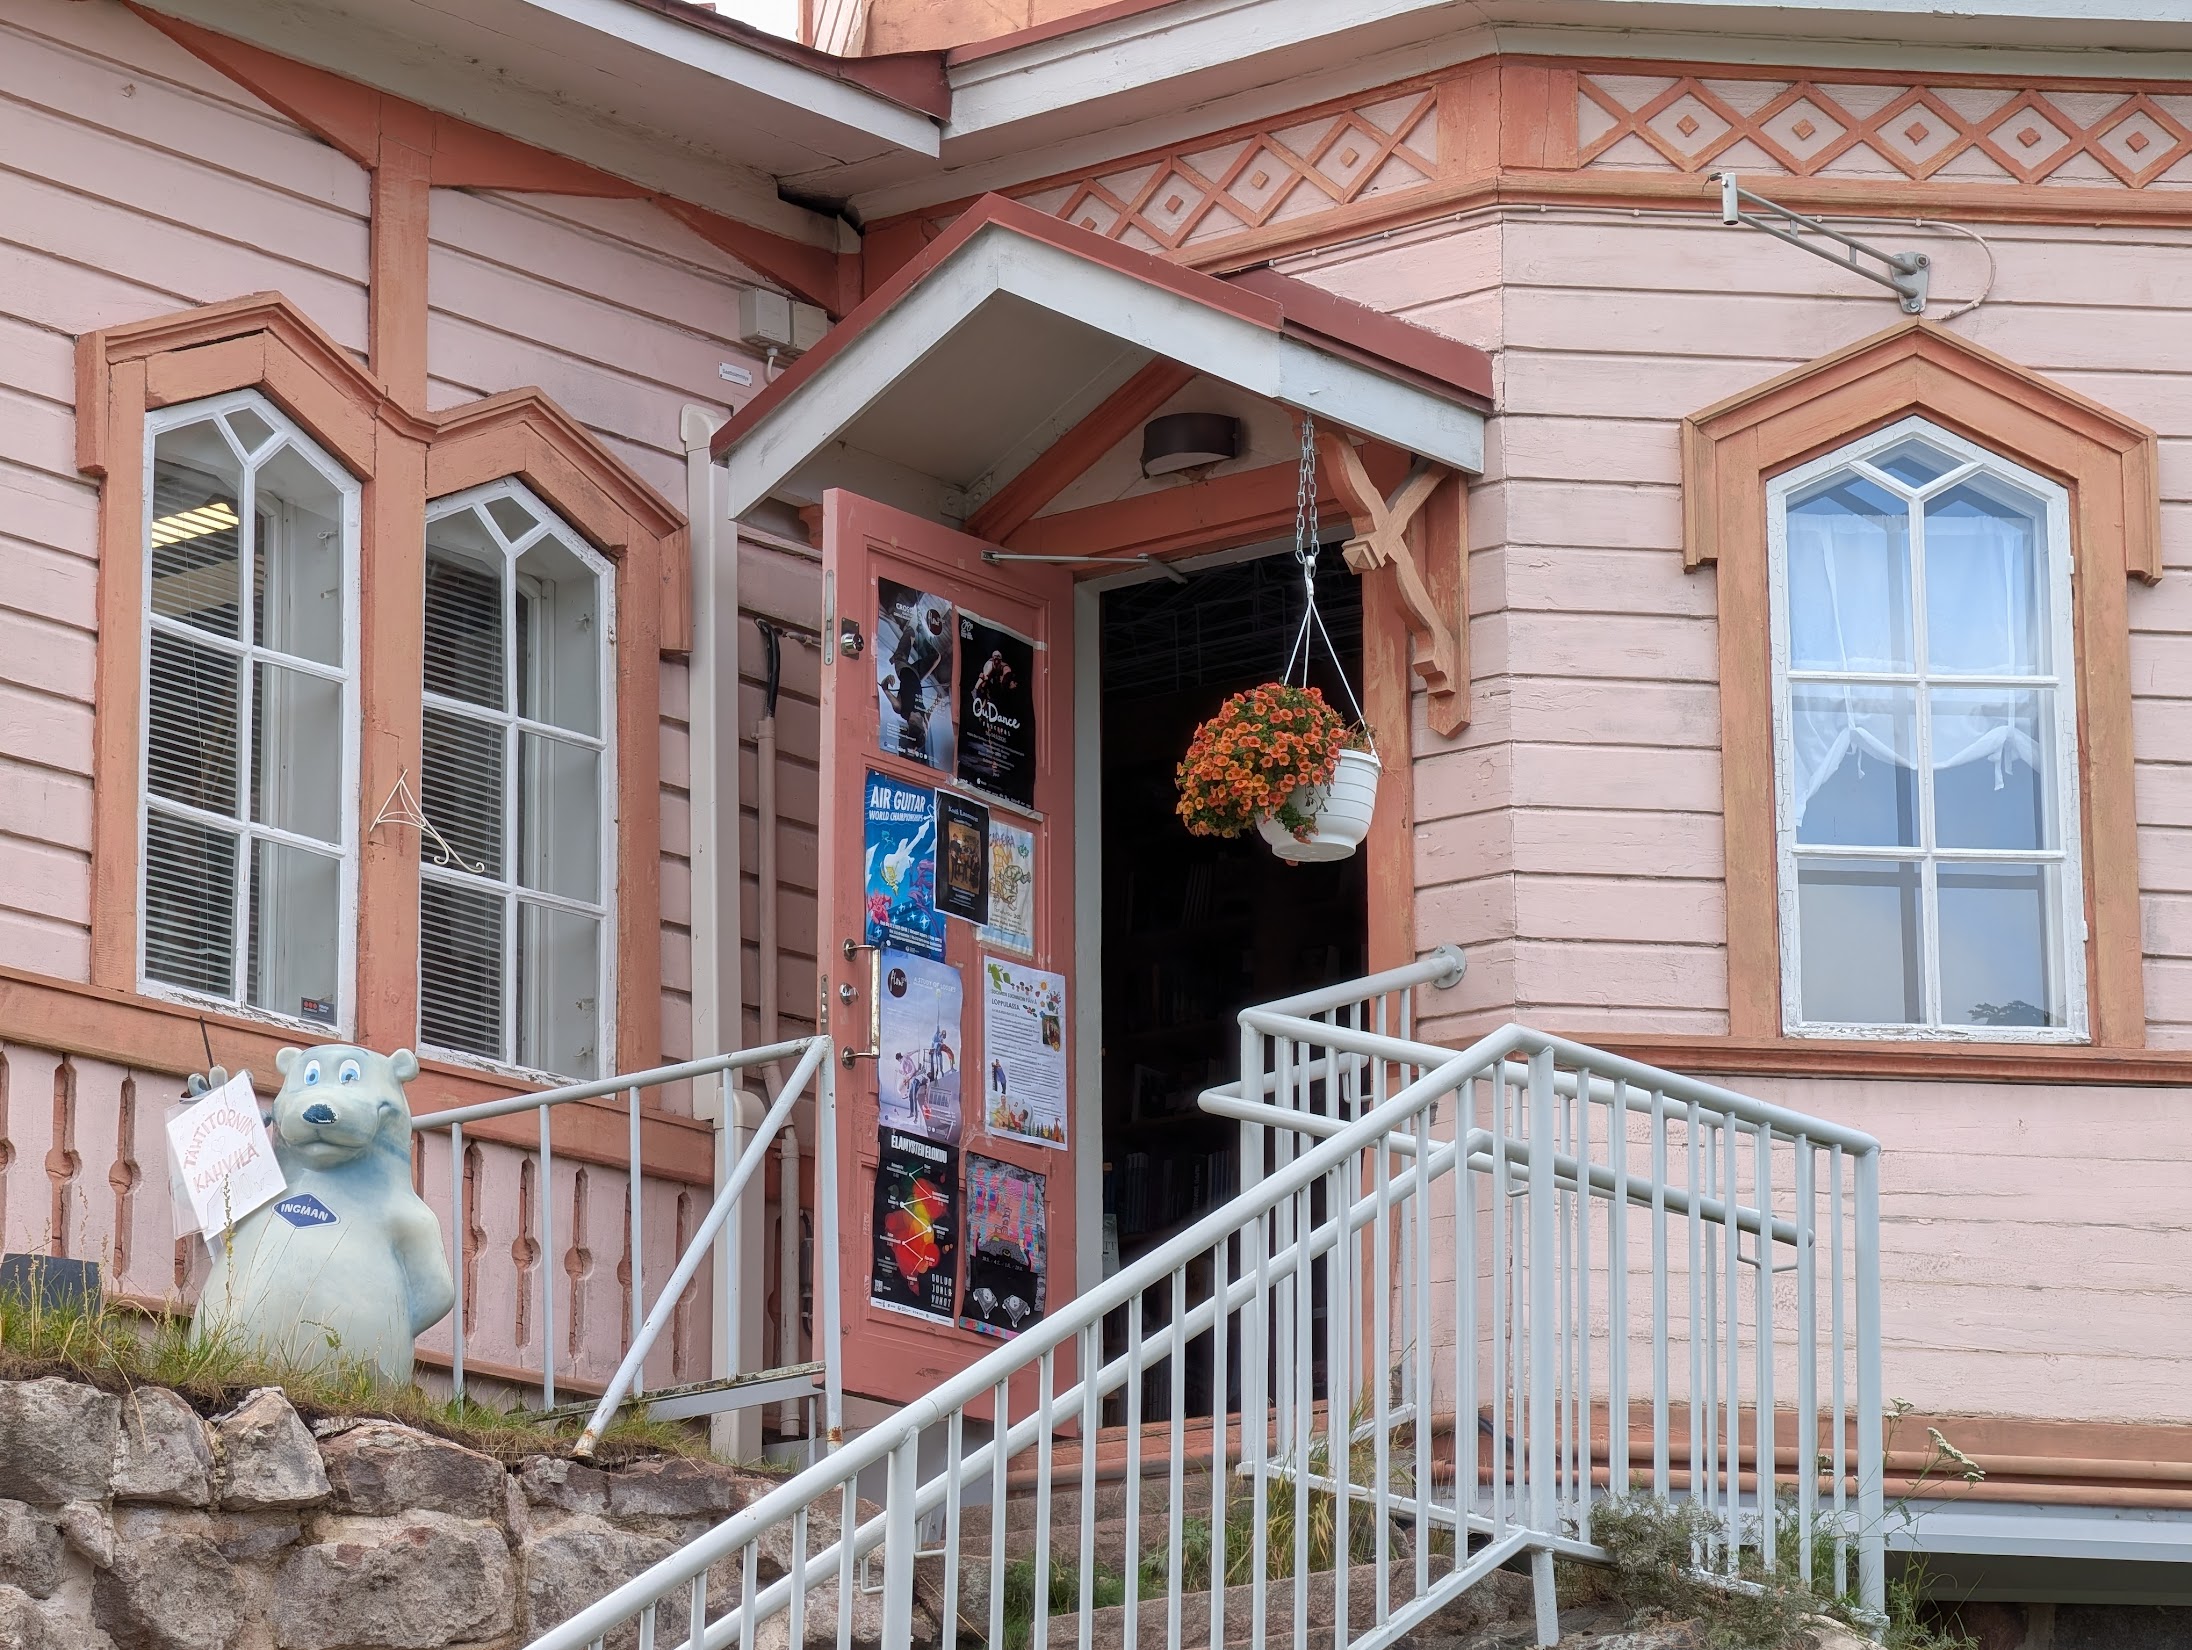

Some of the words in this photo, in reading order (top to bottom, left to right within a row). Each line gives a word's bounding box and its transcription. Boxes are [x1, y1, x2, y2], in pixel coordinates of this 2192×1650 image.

[870, 785, 891, 810] AIR
[894, 790, 926, 812] GUITAR
[869, 810, 890, 821] WORLD
[918, 978, 932, 986] STUDY
[940, 983, 957, 993] LOSSES
[184, 1108, 257, 1170] TÄHTITORNIN
[193, 1142, 260, 1194] KAHVILA
[280, 1203, 329, 1221] INGMAN
